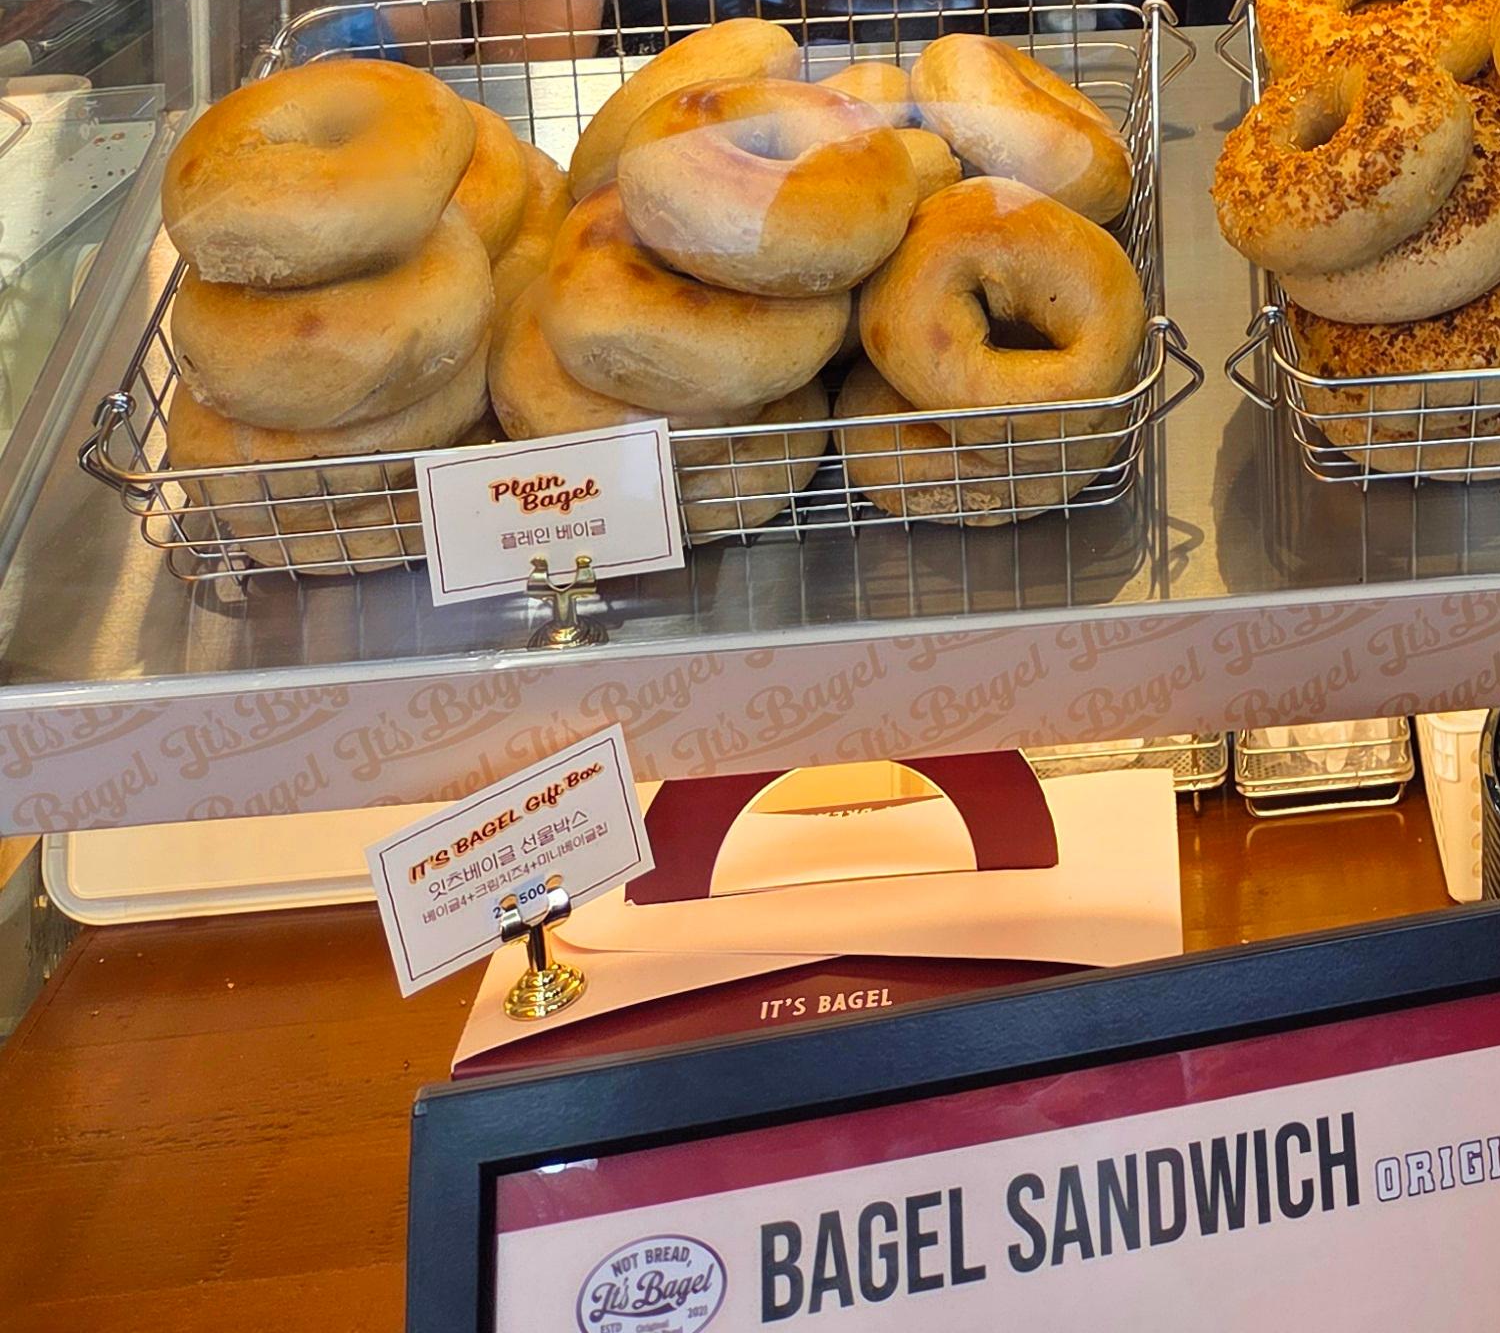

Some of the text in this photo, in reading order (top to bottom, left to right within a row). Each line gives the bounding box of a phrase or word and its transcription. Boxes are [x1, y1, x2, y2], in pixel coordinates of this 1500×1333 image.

[491, 474, 567, 502] Plain
[522, 479, 600, 512] Bagel
[500, 517, 607, 550] 플레인 베이글
[408, 761, 602, 883] IT'S BAGEL Gift Box
[427, 808, 590, 902] 잇츠베이글 선물박스
[759, 988, 894, 1021] IT'S BAGEL
[760, 1185, 987, 1324] BAGEL
[1005, 1111, 1362, 1275] SANDWICH
[610, 1245, 693, 1278] NOT BREAD,
[589, 1263, 715, 1324] It's Bagel
